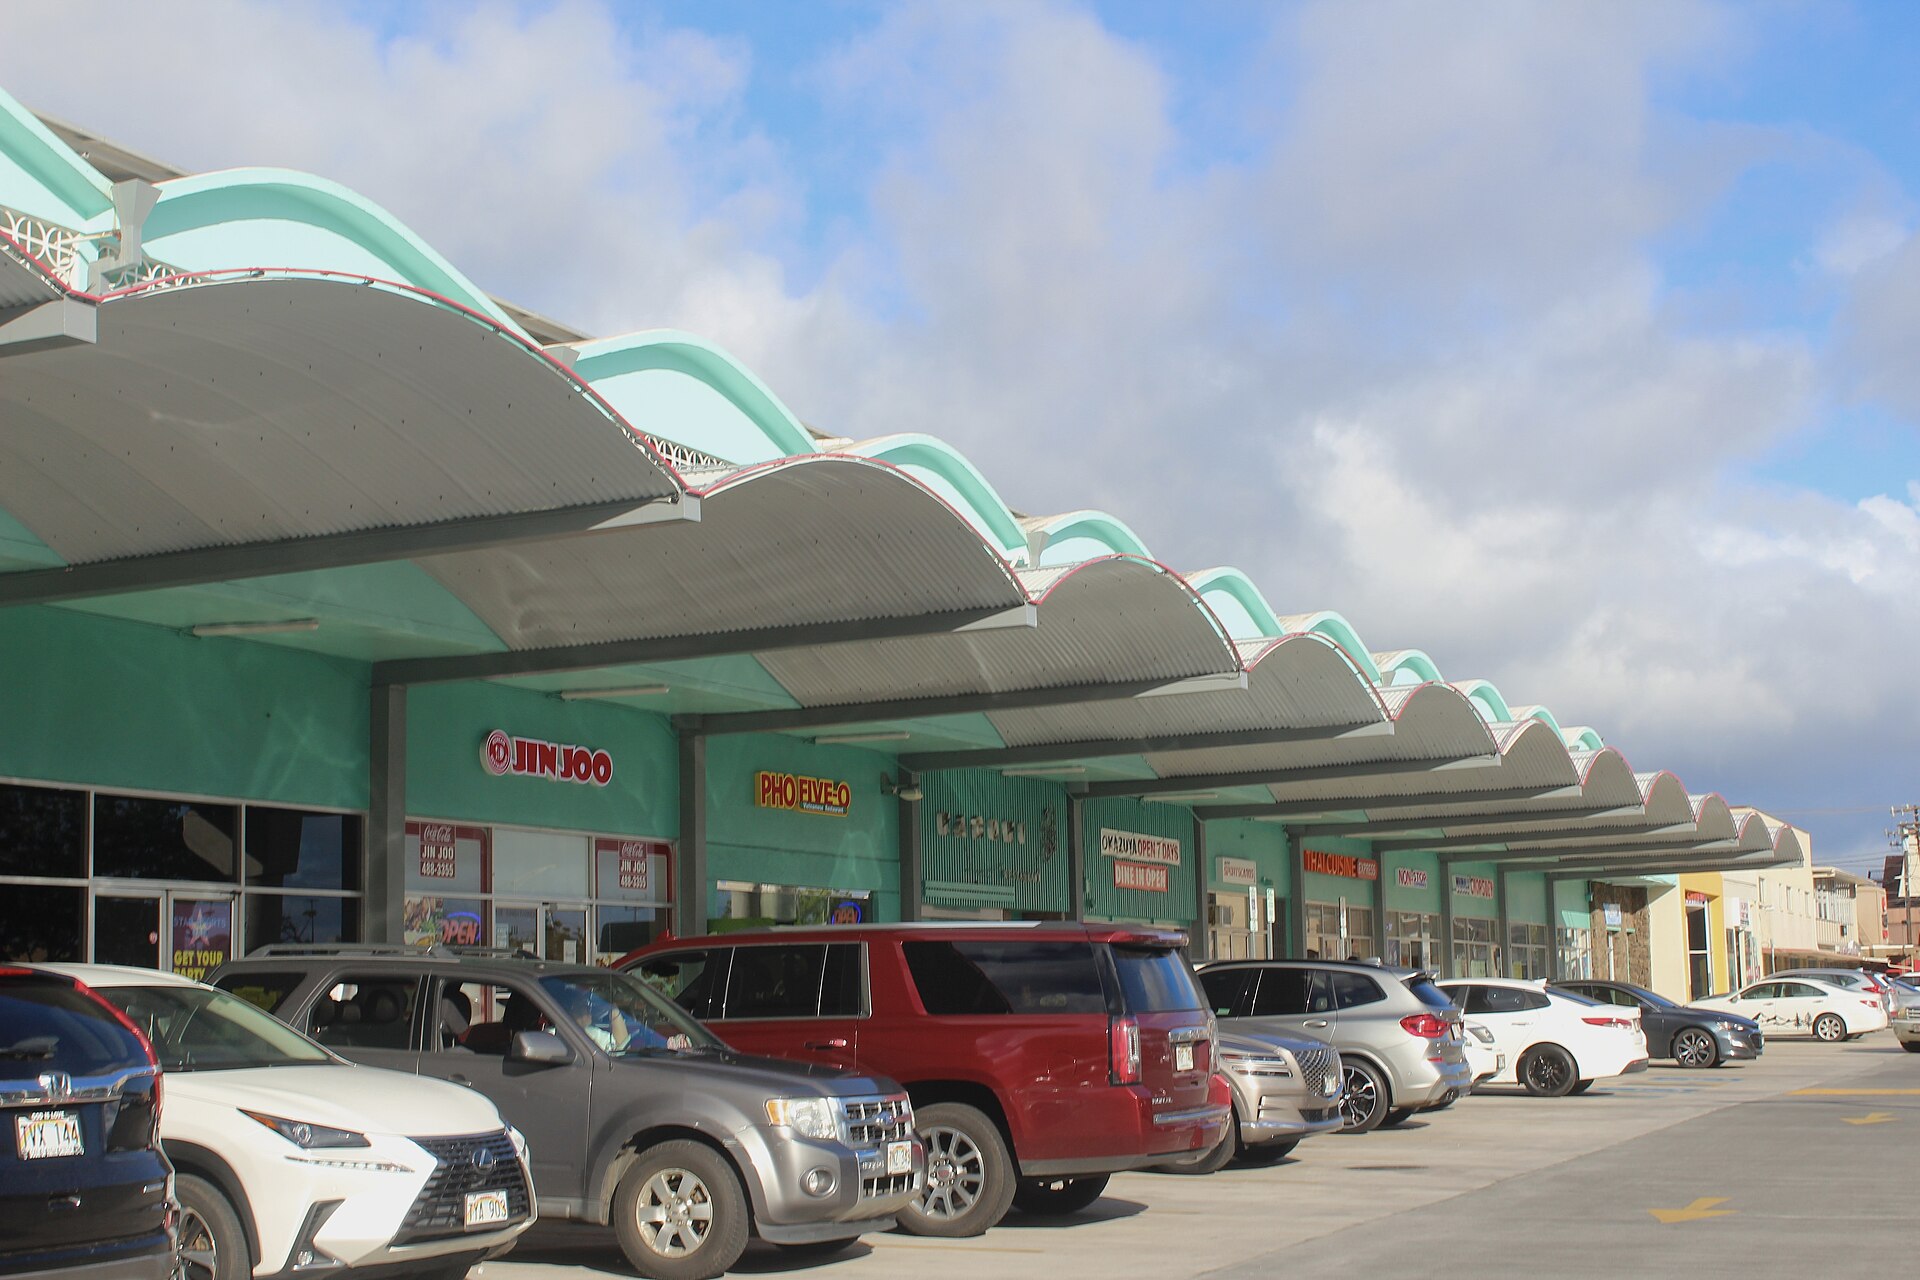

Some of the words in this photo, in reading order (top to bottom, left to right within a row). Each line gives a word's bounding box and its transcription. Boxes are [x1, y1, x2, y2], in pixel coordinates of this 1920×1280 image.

[511, 739, 557, 778] JIN
[559, 747, 612, 785] JOO
[761, 772, 796, 807] PHO
[799, 778, 851, 808] FIVE-O
[421, 845, 436, 859] JIN
[437, 847, 454, 860] JOO
[1138, 839, 1155, 858] OPEN
[1156, 842, 1162, 859] 7
[1162, 843, 1179, 861] DAYS
[620, 859, 631, 872] JIN
[632, 860, 646, 873] JOO
[1305, 850, 1326, 874] THAI
[1326, 853, 1357, 878] CUISINE
[1115, 864, 1134, 886] DINE
[1135, 866, 1145, 887] IN
[1146, 867, 1167, 889] OPEN
[174, 949, 195, 966] GET
[196, 950, 223, 967] YOUR
